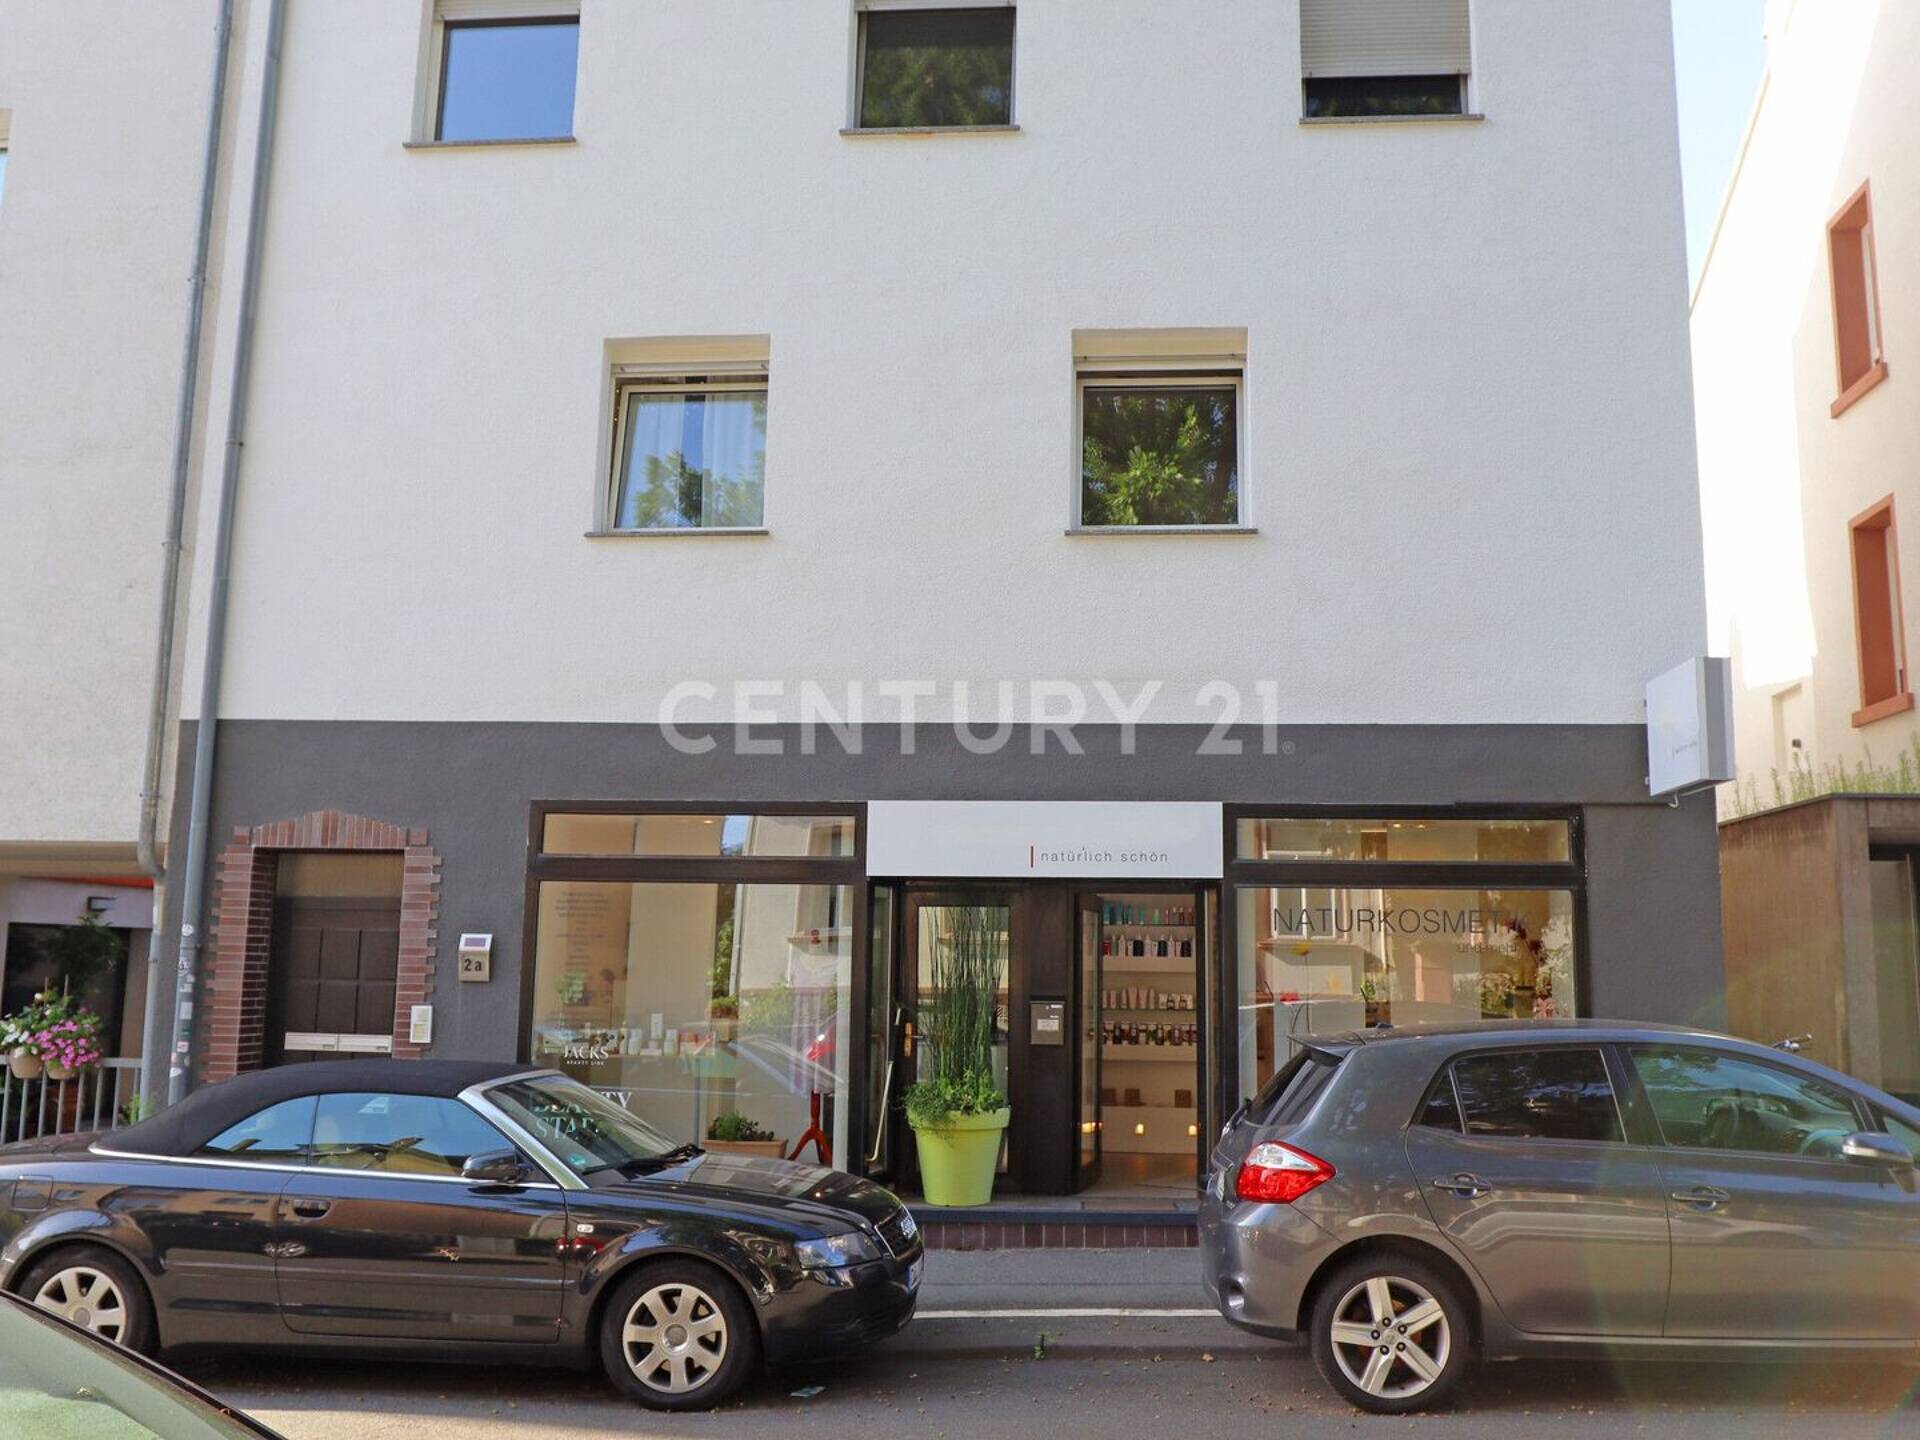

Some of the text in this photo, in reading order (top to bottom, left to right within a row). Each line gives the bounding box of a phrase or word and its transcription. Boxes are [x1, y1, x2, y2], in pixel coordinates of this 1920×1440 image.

[1120, 850, 1168, 863] schön
[463, 958, 482, 972] 2a
[563, 1045, 609, 1060] JACKS
